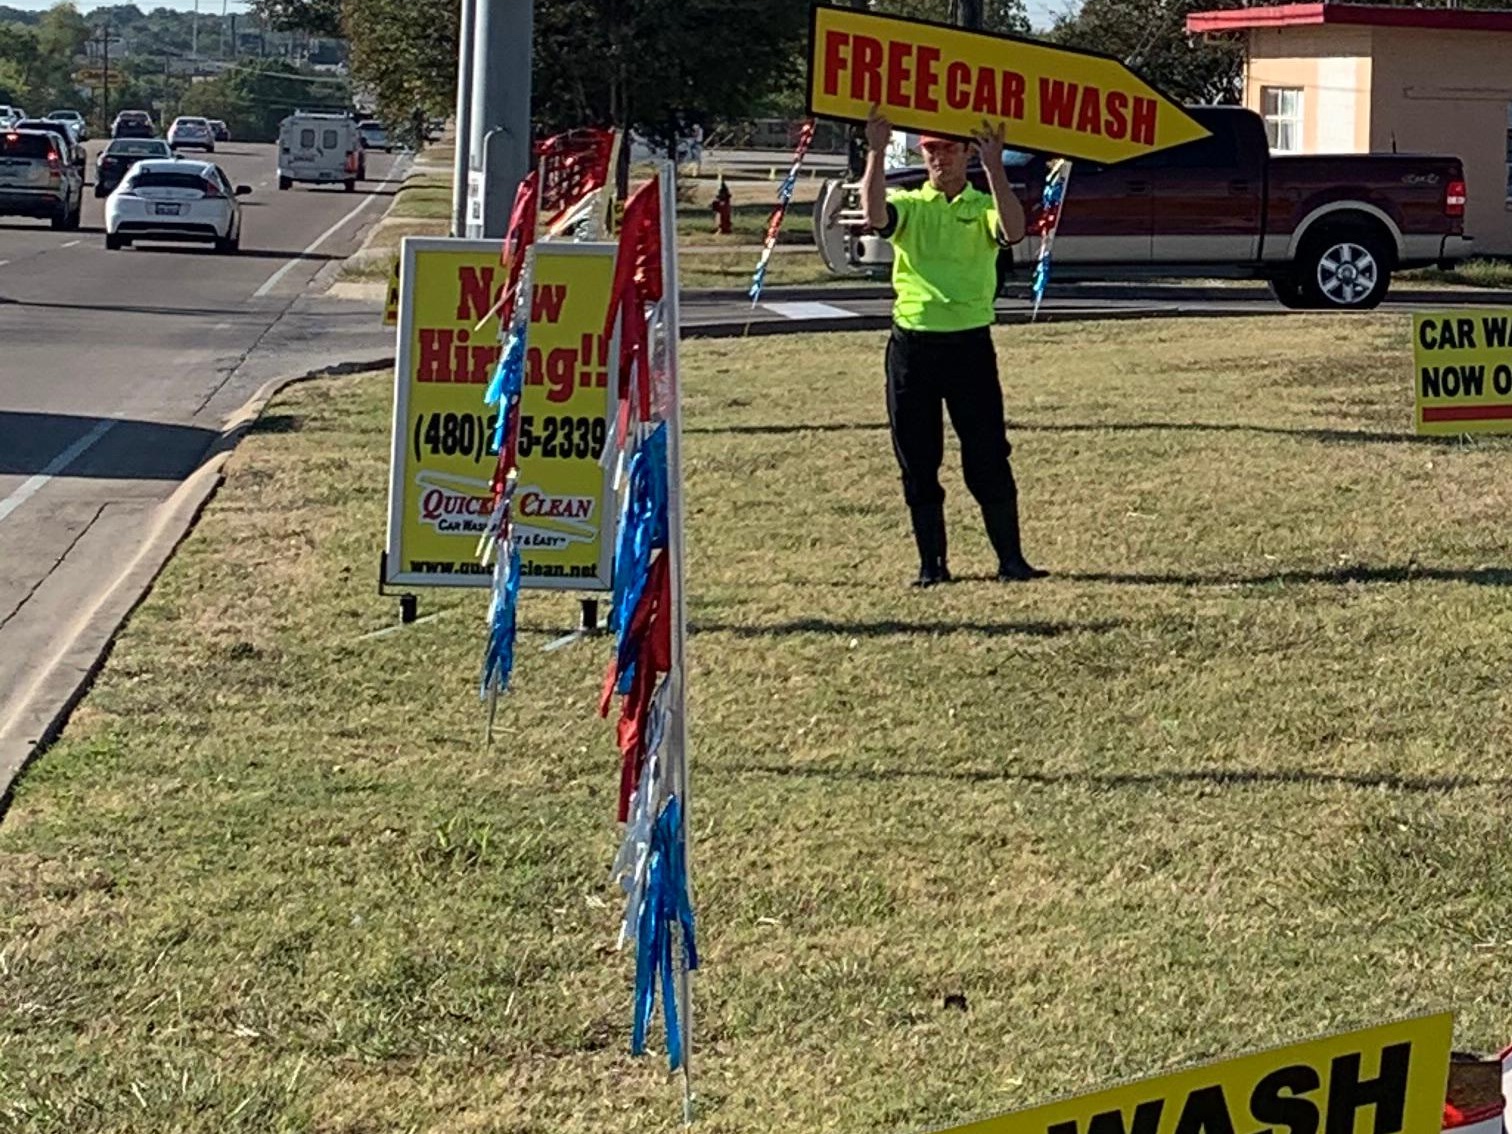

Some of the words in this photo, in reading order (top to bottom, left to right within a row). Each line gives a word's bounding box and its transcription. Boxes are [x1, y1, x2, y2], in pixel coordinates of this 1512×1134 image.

[824, 30, 941, 113] FREE
[946, 61, 1026, 120] CAR
[1039, 76, 1158, 146] WASH
[1419, 319, 1477, 350] CAR
[417, 328, 610, 403] Hirng!!
[1421, 365, 1485, 397] NOW
[414, 412, 606, 463] (480)25-2339
[520, 492, 592, 518] CLEAN
